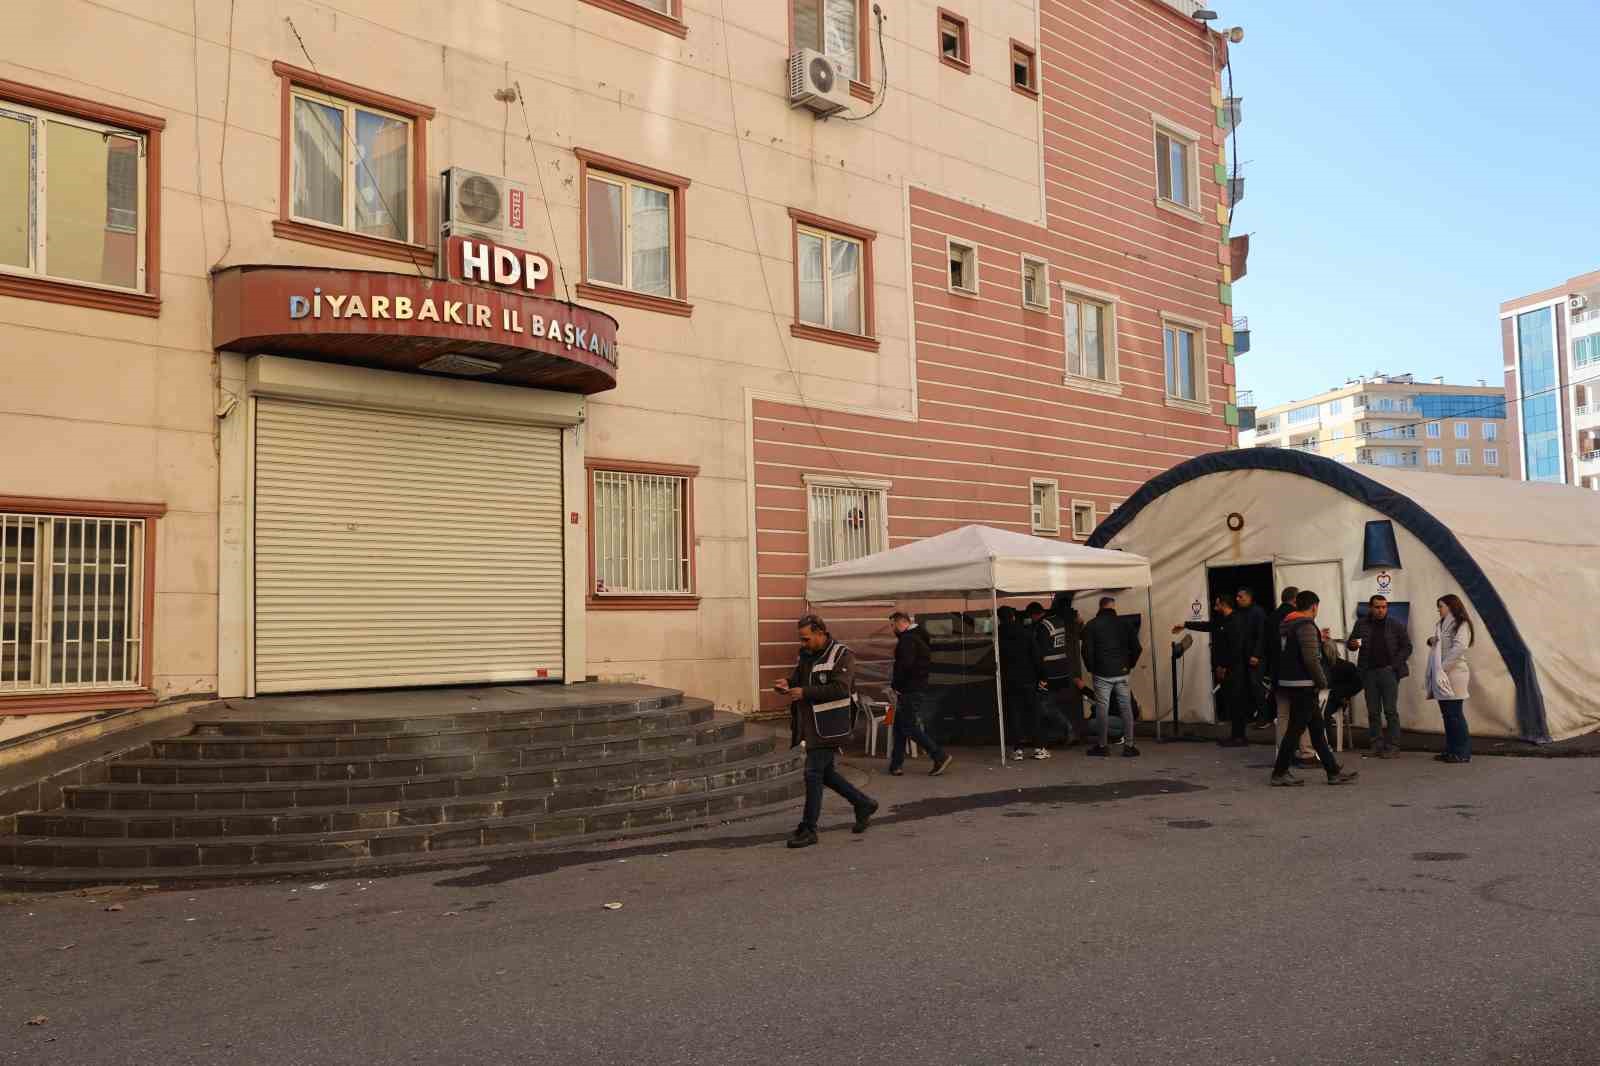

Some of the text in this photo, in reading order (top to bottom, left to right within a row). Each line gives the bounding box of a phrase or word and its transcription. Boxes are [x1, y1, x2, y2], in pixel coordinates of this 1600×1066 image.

[512, 190, 521, 227] VESTEL
[463, 240, 549, 290] HDP
[290, 287, 492, 328] DİYARBAKIR
